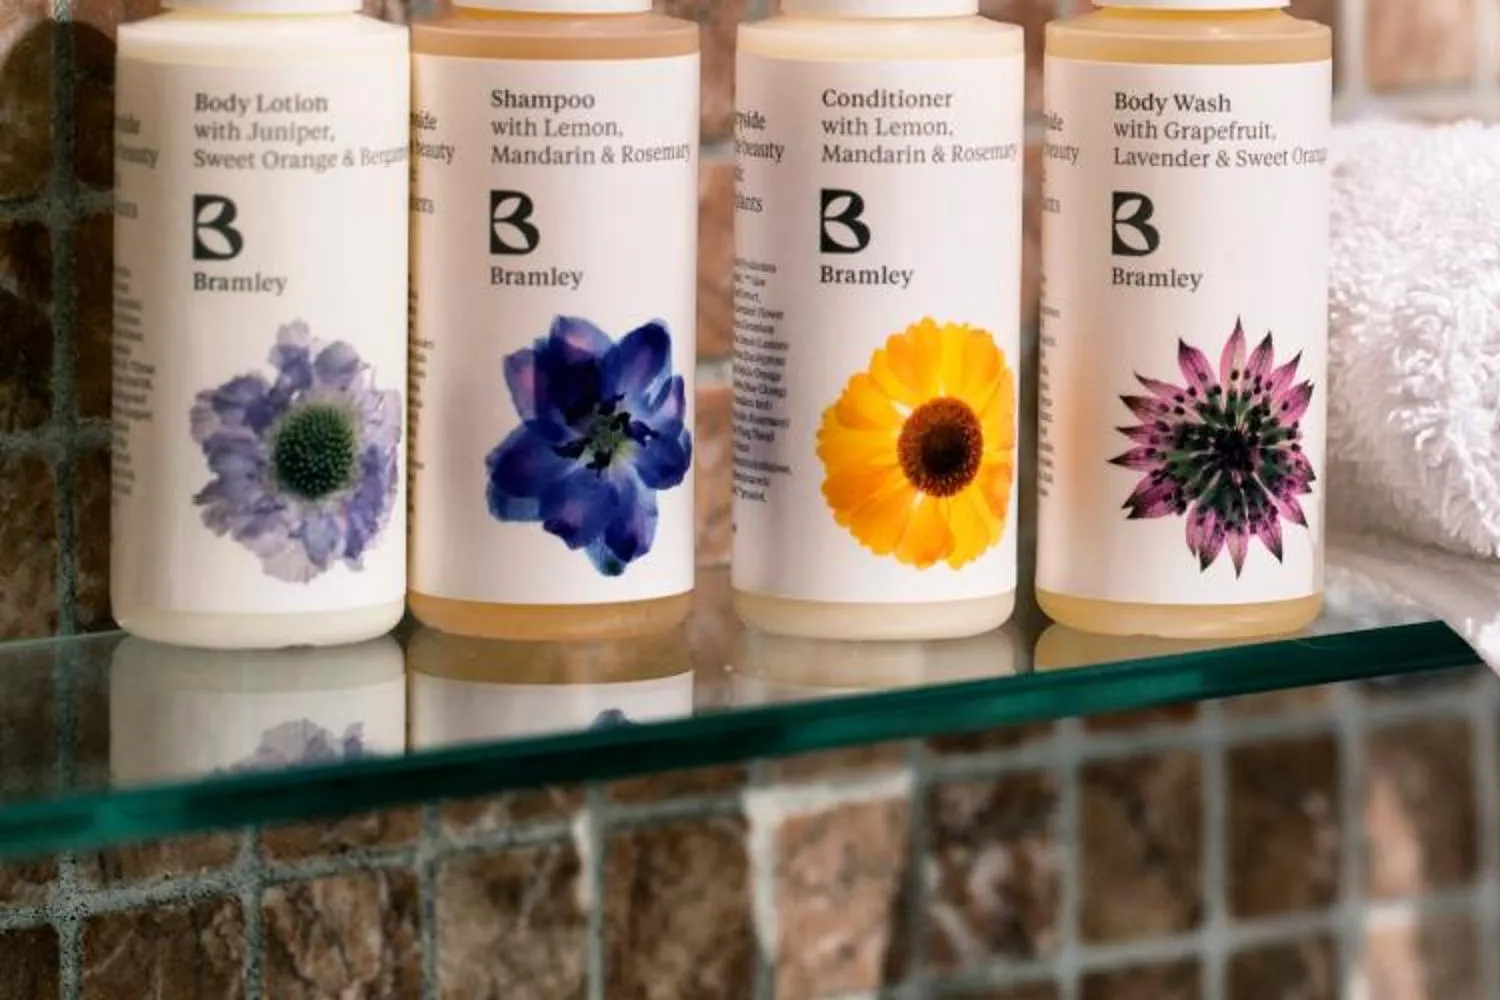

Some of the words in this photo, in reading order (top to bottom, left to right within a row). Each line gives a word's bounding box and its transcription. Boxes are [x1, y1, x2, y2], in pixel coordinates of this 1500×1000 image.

[194, 92, 250, 116] Body
[256, 94, 329, 113] Lotion
[490, 89, 595, 112] Shampoo
[822, 88, 953, 109] Conditioner
[1114, 91, 1168, 116] Body
[1173, 94, 1232, 113] Wash
[194, 122, 240, 142] with
[246, 122, 336, 146] Juniper,
[490, 118, 537, 137] with
[544, 119, 623, 138] Lemon,
[821, 117, 867, 136] with
[875, 118, 954, 137] Lemon,
[1113, 121, 1157, 140] with
[1164, 121, 1277, 144] Grapefruit,
[193, 149, 254, 170] Sweet
[262, 150, 338, 174] Orange
[341, 150, 354, 167] &
[490, 145, 596, 166] Mandarin
[601, 147, 615, 165] &
[621, 144, 691, 164] Rosemary
[821, 145, 926, 164] Mandarin
[932, 146, 945, 163] &
[951, 143, 1018, 163] Rosemary
[1113, 147, 1210, 168] Lavender
[1215, 149, 1230, 168] &
[1235, 148, 1288, 168] Sweet
[193, 271, 288, 296] Bramley
[489, 266, 584, 290] Bramley
[820, 265, 914, 289] Bramley
[1112, 267, 1203, 292] Bramley
